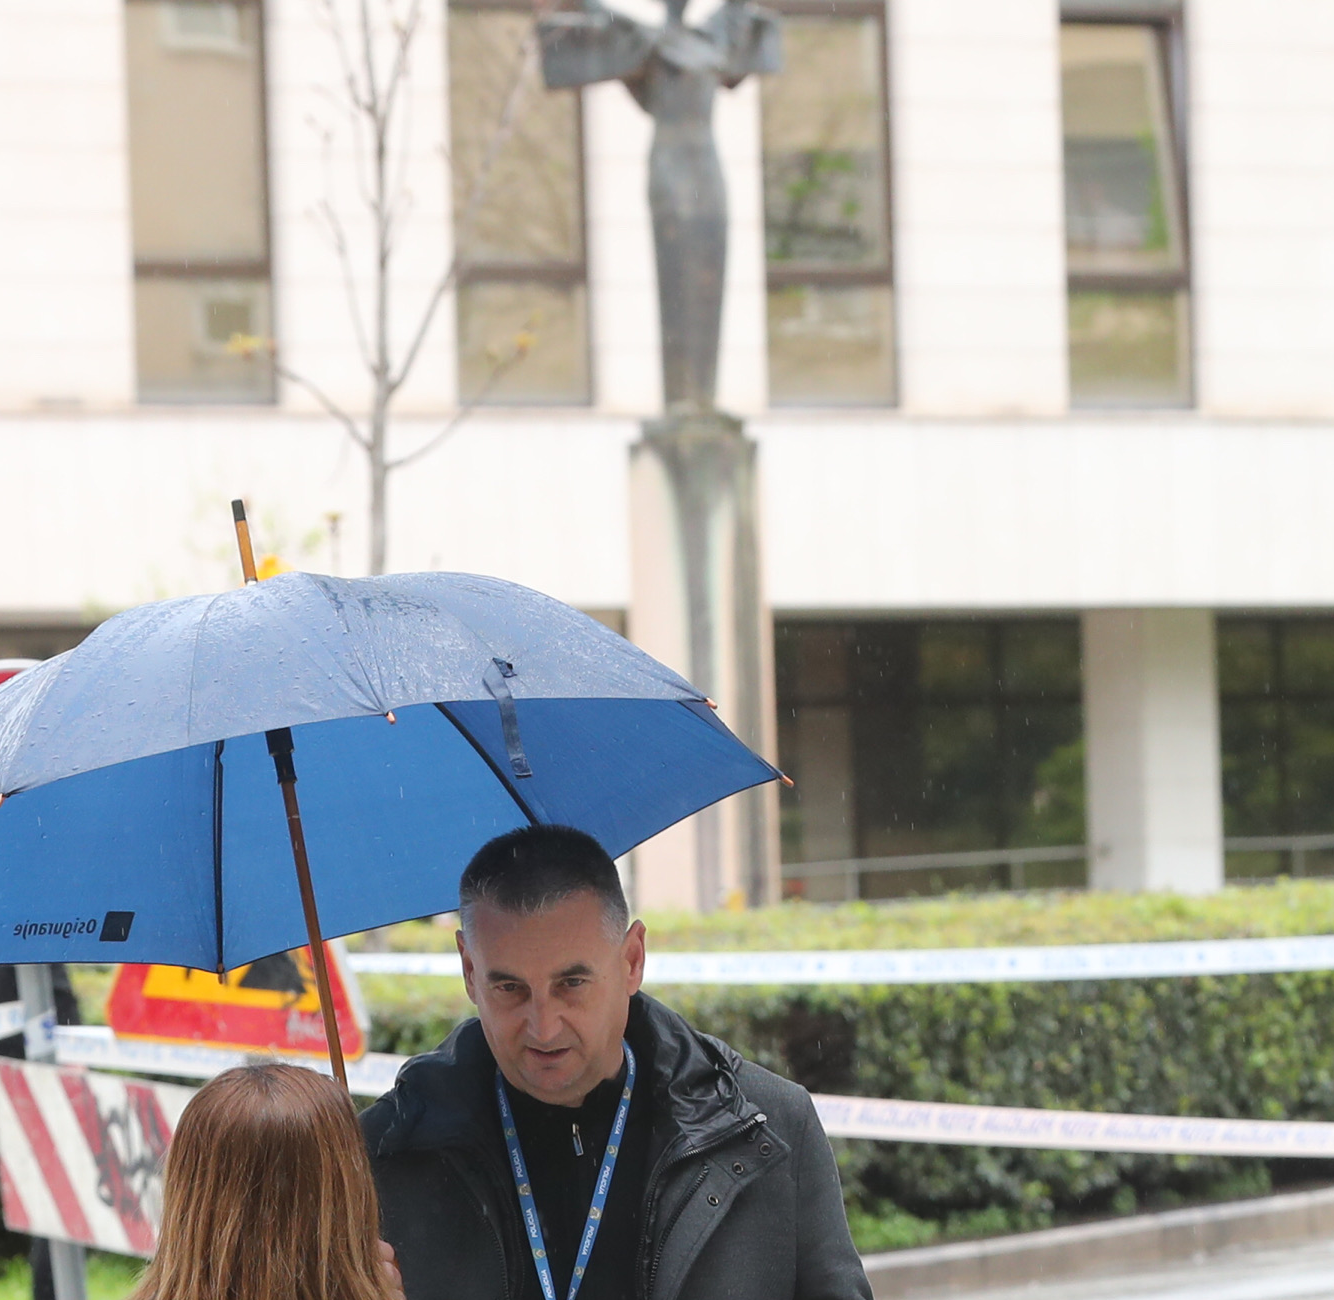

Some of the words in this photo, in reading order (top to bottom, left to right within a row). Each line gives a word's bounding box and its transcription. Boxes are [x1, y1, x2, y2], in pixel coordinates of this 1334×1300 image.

[614, 1105, 627, 1136] POLICIJA
[597, 1164, 611, 1195] POLICIJA
[525, 1207, 539, 1239] POLICIJA
[581, 1225, 595, 1256] POLICIJA
